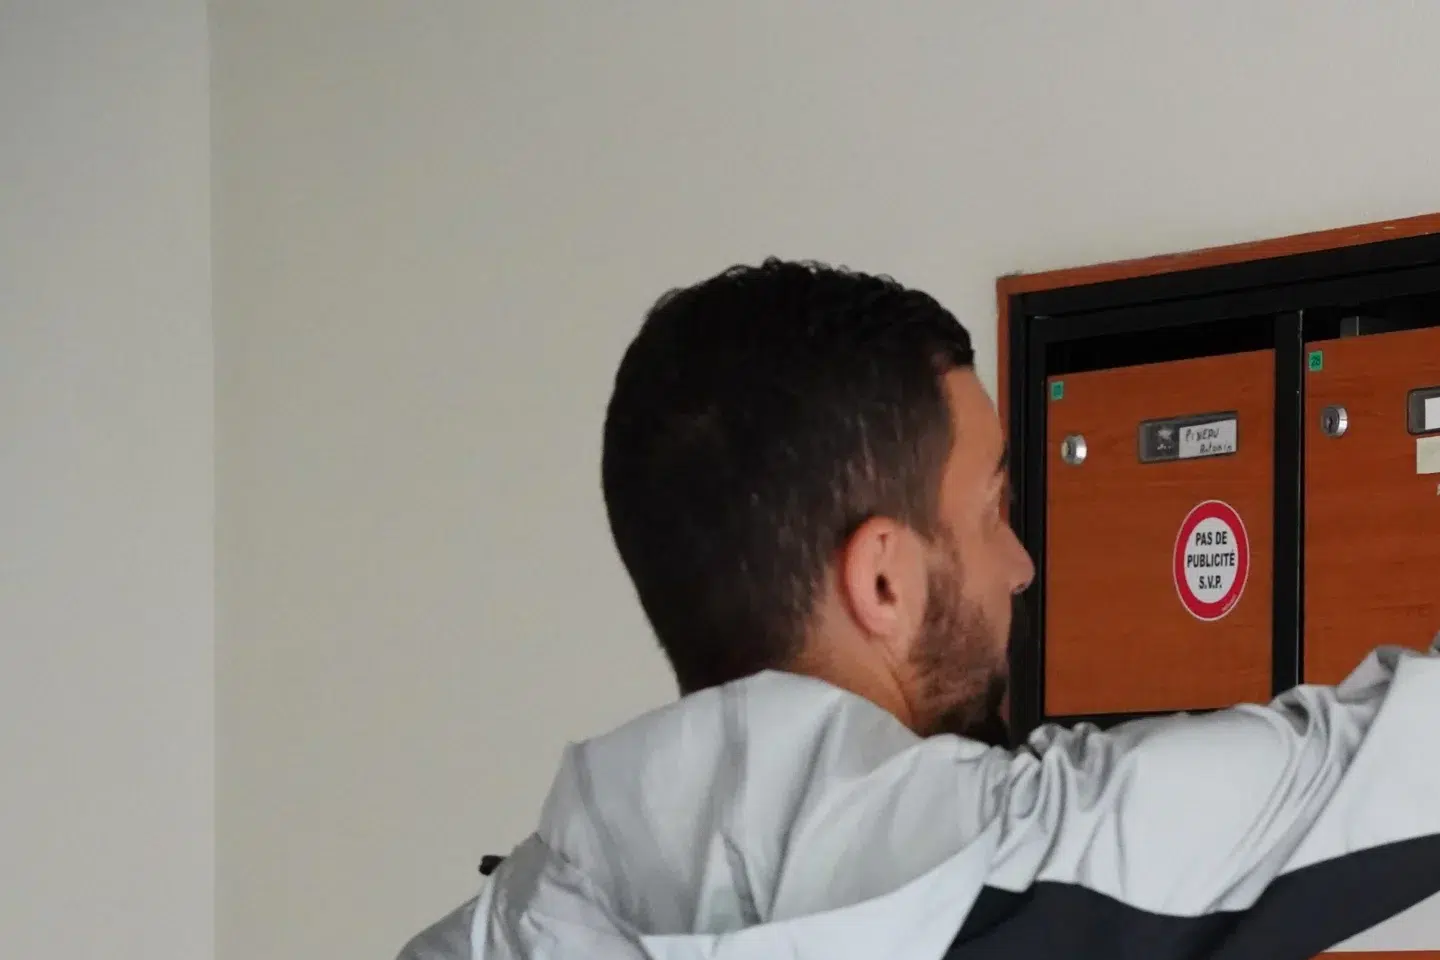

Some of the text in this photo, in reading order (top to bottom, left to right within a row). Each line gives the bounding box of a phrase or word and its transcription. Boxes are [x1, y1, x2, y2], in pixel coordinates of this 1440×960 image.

[1195, 531, 1228, 546] PAS DE
[1187, 549, 1236, 568] PUBLICITÉ
[1198, 575, 1222, 589] S.V.P.
